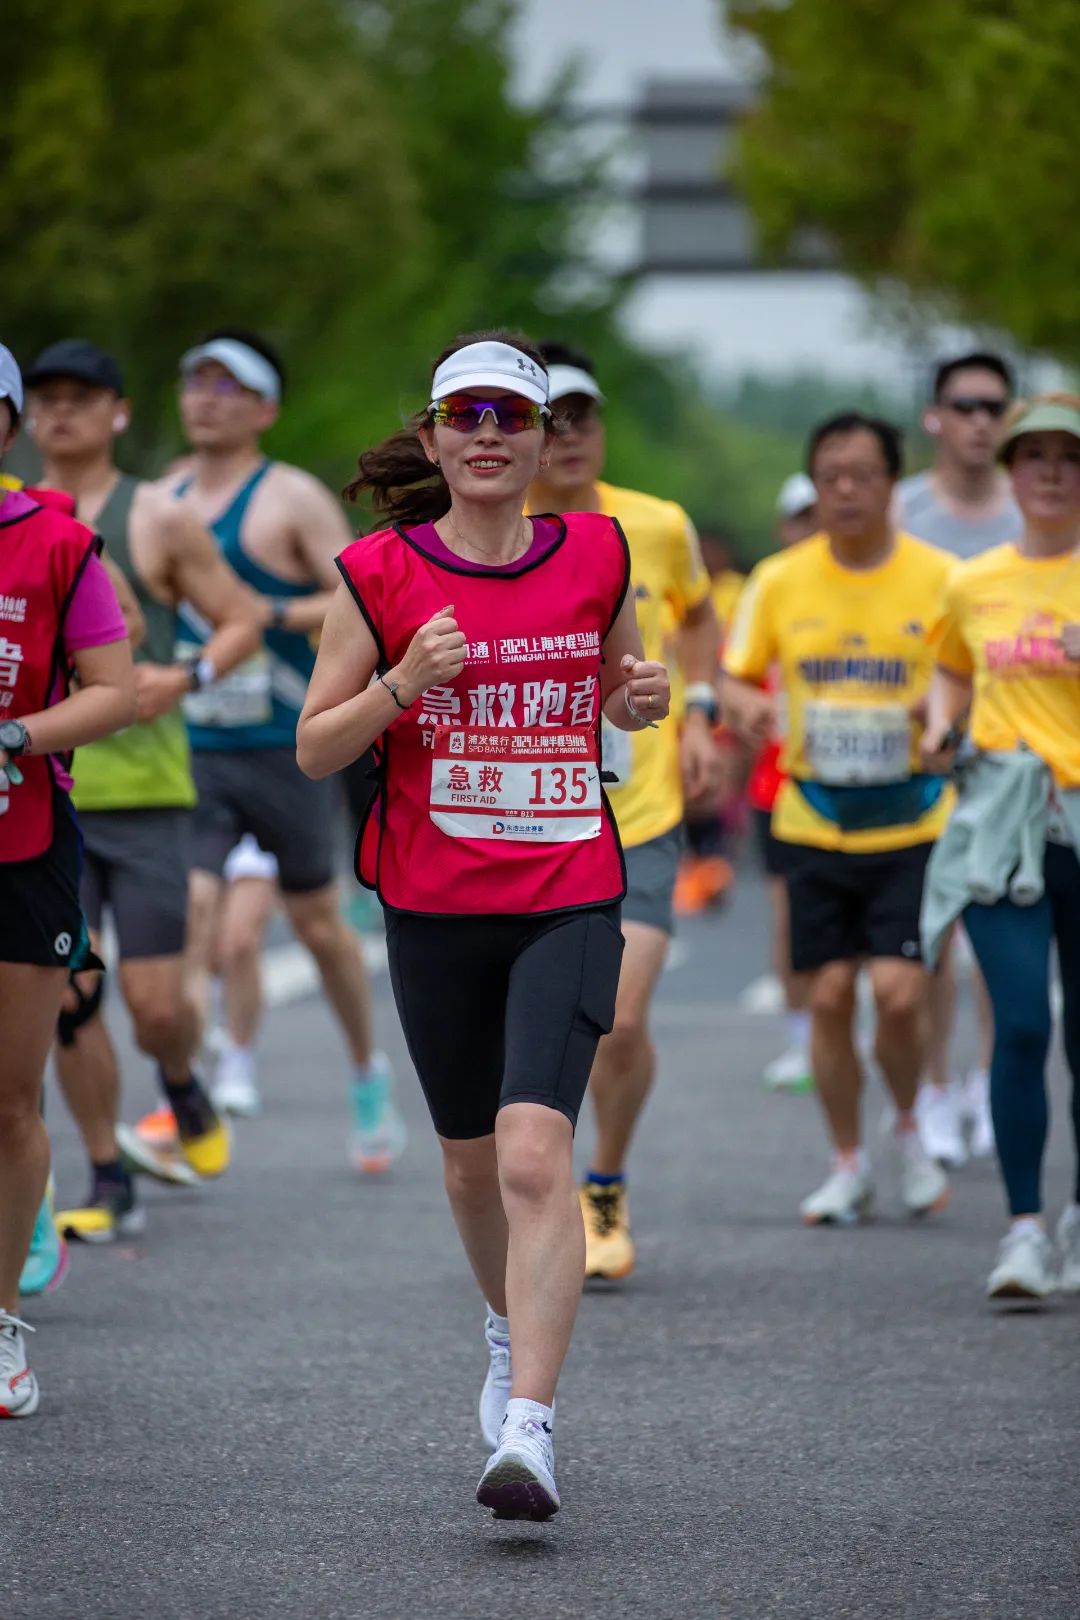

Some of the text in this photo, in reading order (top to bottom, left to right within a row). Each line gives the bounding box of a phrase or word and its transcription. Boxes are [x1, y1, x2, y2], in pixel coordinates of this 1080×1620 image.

[501, 652, 546, 664] SHANGHAI
[548, 651, 570, 661] HALF
[417, 675, 597, 728] 急救跑者
[468, 734, 509, 747] 浦发银行
[511, 734, 587, 748] 2024上海半程马拉松
[468, 745, 507, 754] SPD BANK
[511, 747, 543, 755] SHANGHAI
[447, 764, 504, 793] 急救
[528, 767, 588, 805] 135
[451, 793, 497, 805] FIRST AID
[520, 810, 535, 818] B13
